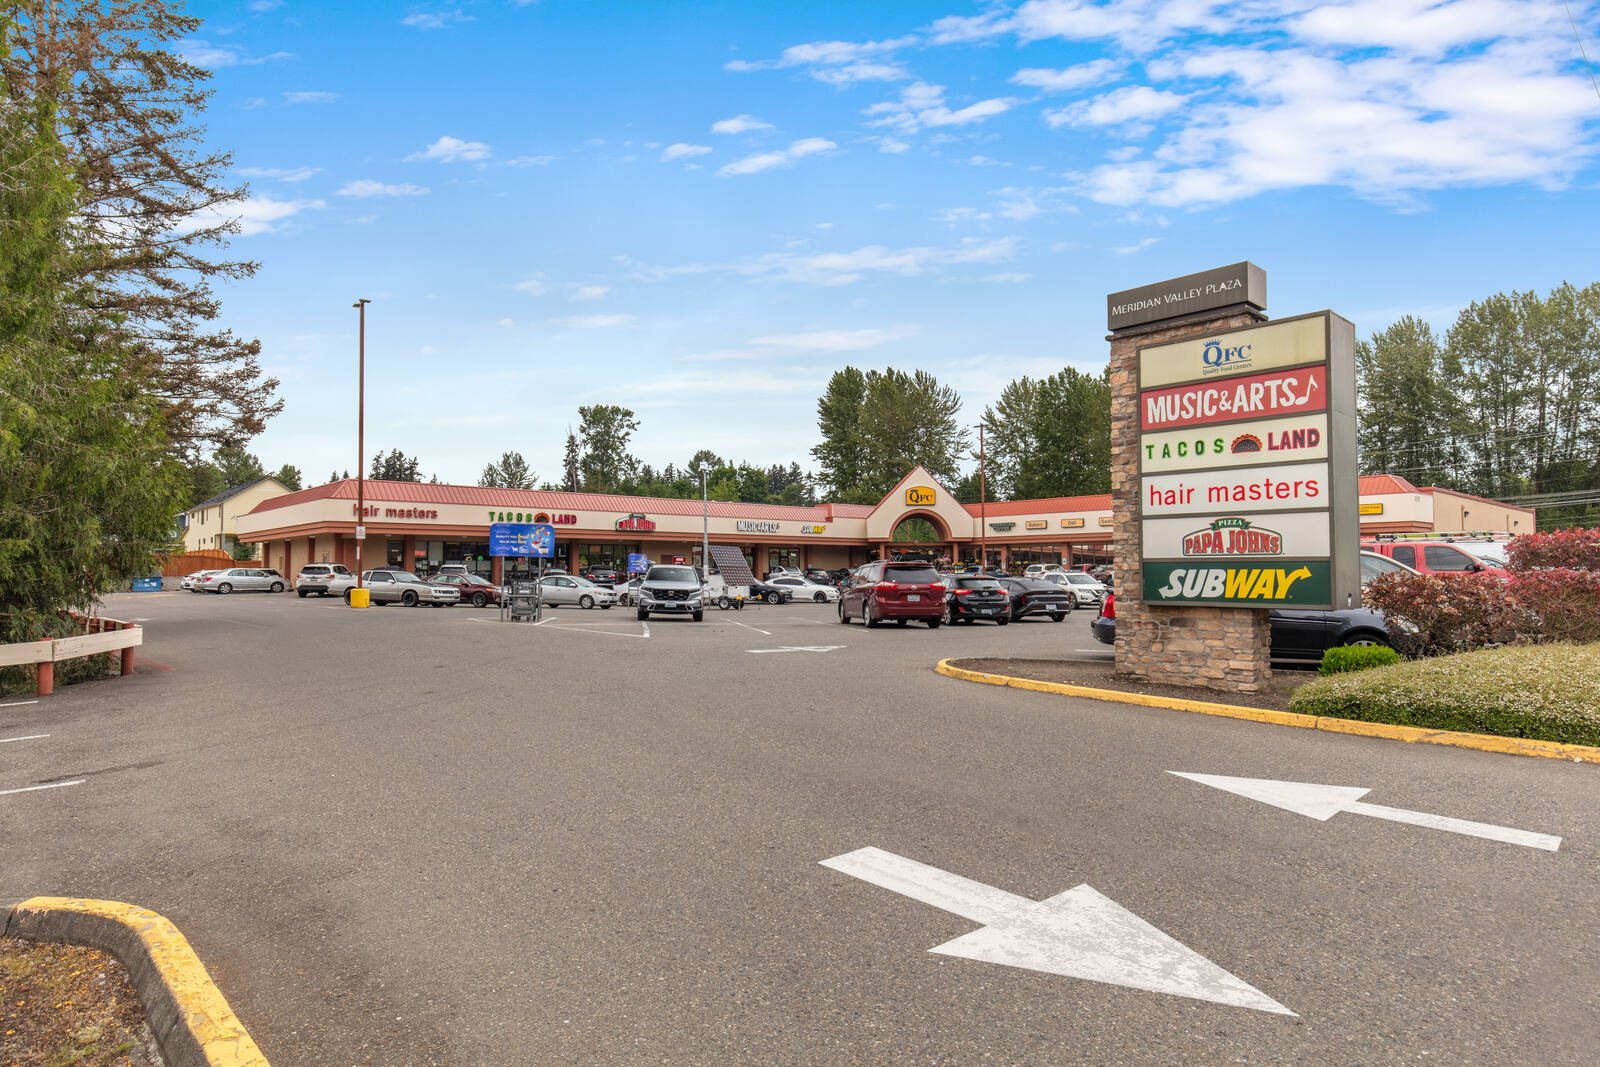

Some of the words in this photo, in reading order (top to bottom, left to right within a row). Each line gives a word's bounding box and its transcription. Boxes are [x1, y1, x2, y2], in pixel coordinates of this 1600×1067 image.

[1111, 298, 1161, 316] MERIDIAN
[1164, 288, 1202, 303] VALLEY
[1206, 279, 1242, 294] PLAZA
[1203, 344, 1252, 367] QFC
[1147, 377, 1298, 424] MUSIC&ARTS
[1145, 438, 1225, 460] TACOS
[1267, 428, 1320, 451] LAND
[909, 490, 933, 504] QFC
[1150, 483, 1195, 506] hair
[1208, 478, 1319, 503] masters
[385, 507, 439, 519] masters
[488, 511, 533, 523] TACOS
[551, 513, 577, 526] LAND
[1217, 519, 1243, 527] PIZZA
[1184, 531, 1224, 554] PAPA
[1160, 568, 1296, 600] SUBWAY
